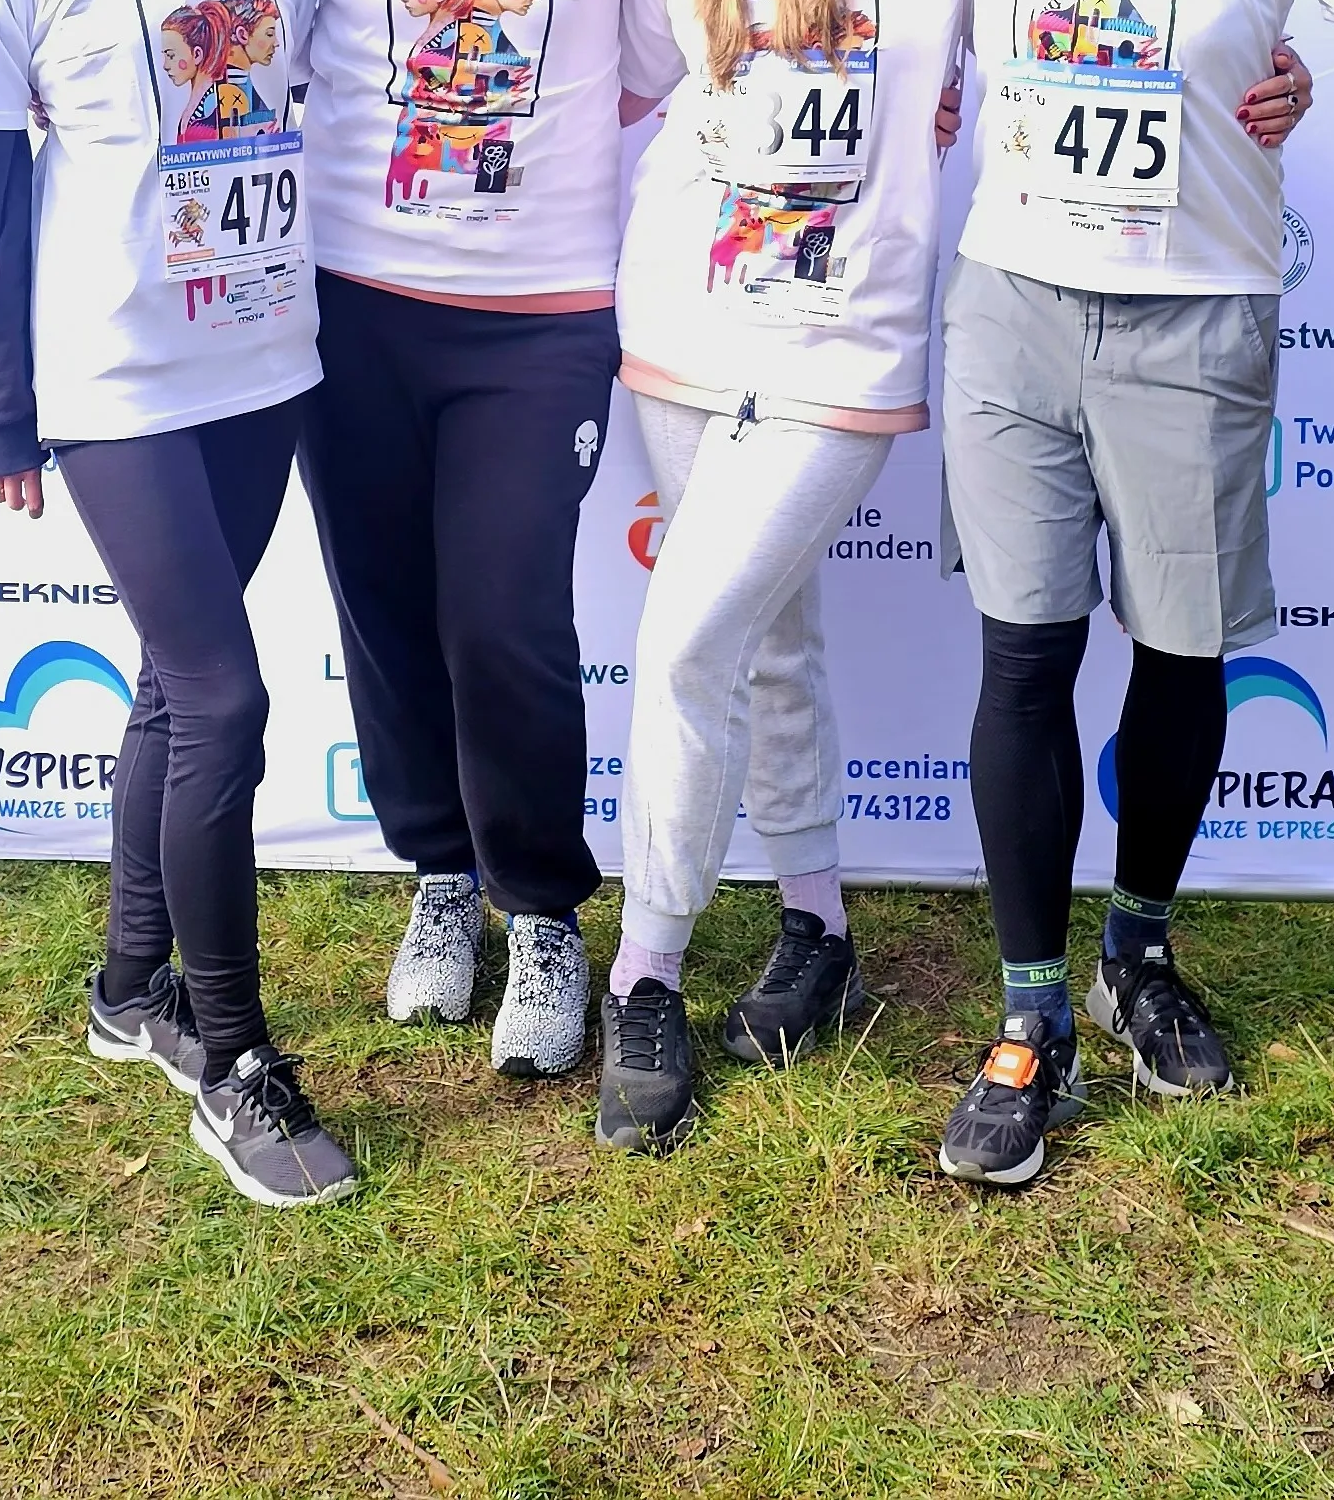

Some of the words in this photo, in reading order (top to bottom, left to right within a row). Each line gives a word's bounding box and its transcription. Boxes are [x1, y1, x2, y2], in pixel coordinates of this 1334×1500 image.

[1053, 104, 1167, 180] 475
[220, 168, 298, 246] 479
[846, 753, 971, 780] oceniam
[842, 794, 952, 822] 743128
[1195, 820, 1248, 840] ARZE
